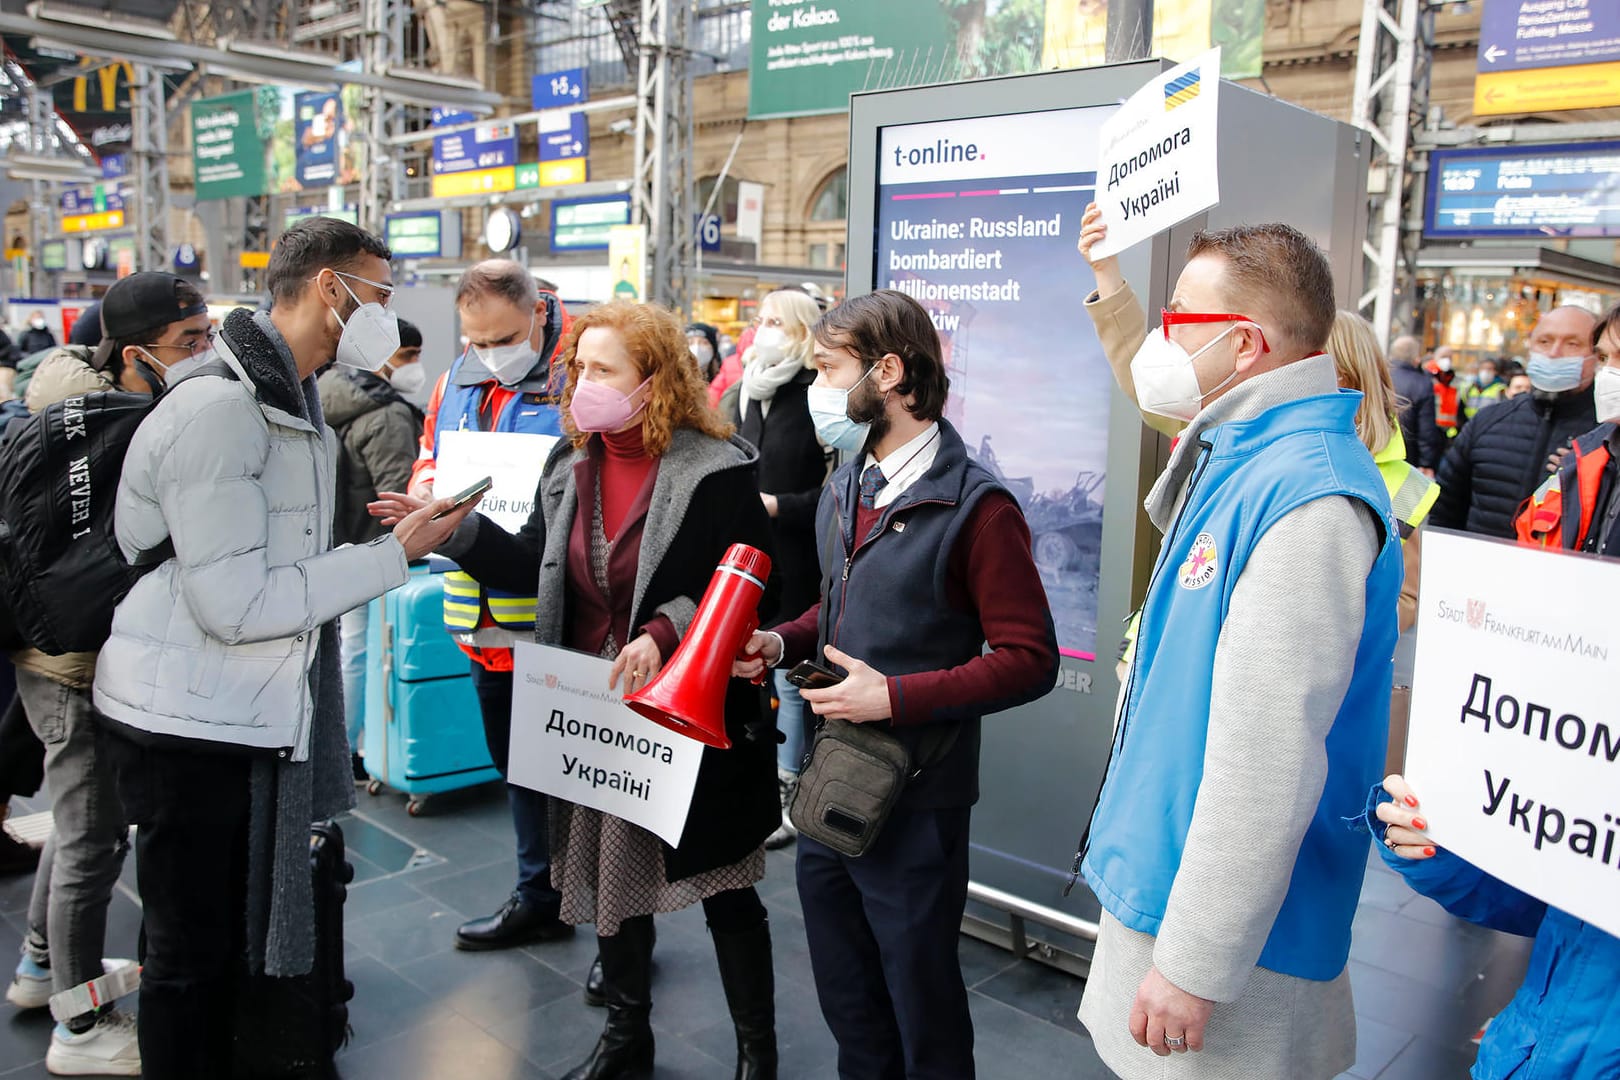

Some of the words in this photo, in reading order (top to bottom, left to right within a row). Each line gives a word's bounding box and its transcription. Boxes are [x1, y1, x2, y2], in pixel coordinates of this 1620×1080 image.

[767, 11, 791, 31] der
[793, 6, 840, 28] Kakao.
[894, 139, 985, 167] t-online.
[1107, 126, 1191, 192] Допомога
[1120, 170, 1180, 221] Україні
[703, 215, 719, 245] 6
[890, 219, 964, 240] Ukraine:
[969, 213, 1061, 238] Russland
[889, 248, 1002, 271] bombardiert
[888, 278, 1021, 301] Millionenstadt
[928, 309, 960, 331] kiw
[69, 456, 91, 525] NEVER
[481, 496, 507, 513] FÜR
[545, 709, 673, 764] Допомога
[562, 753, 651, 801] Україні
[1482, 769, 1620, 870] Украї
